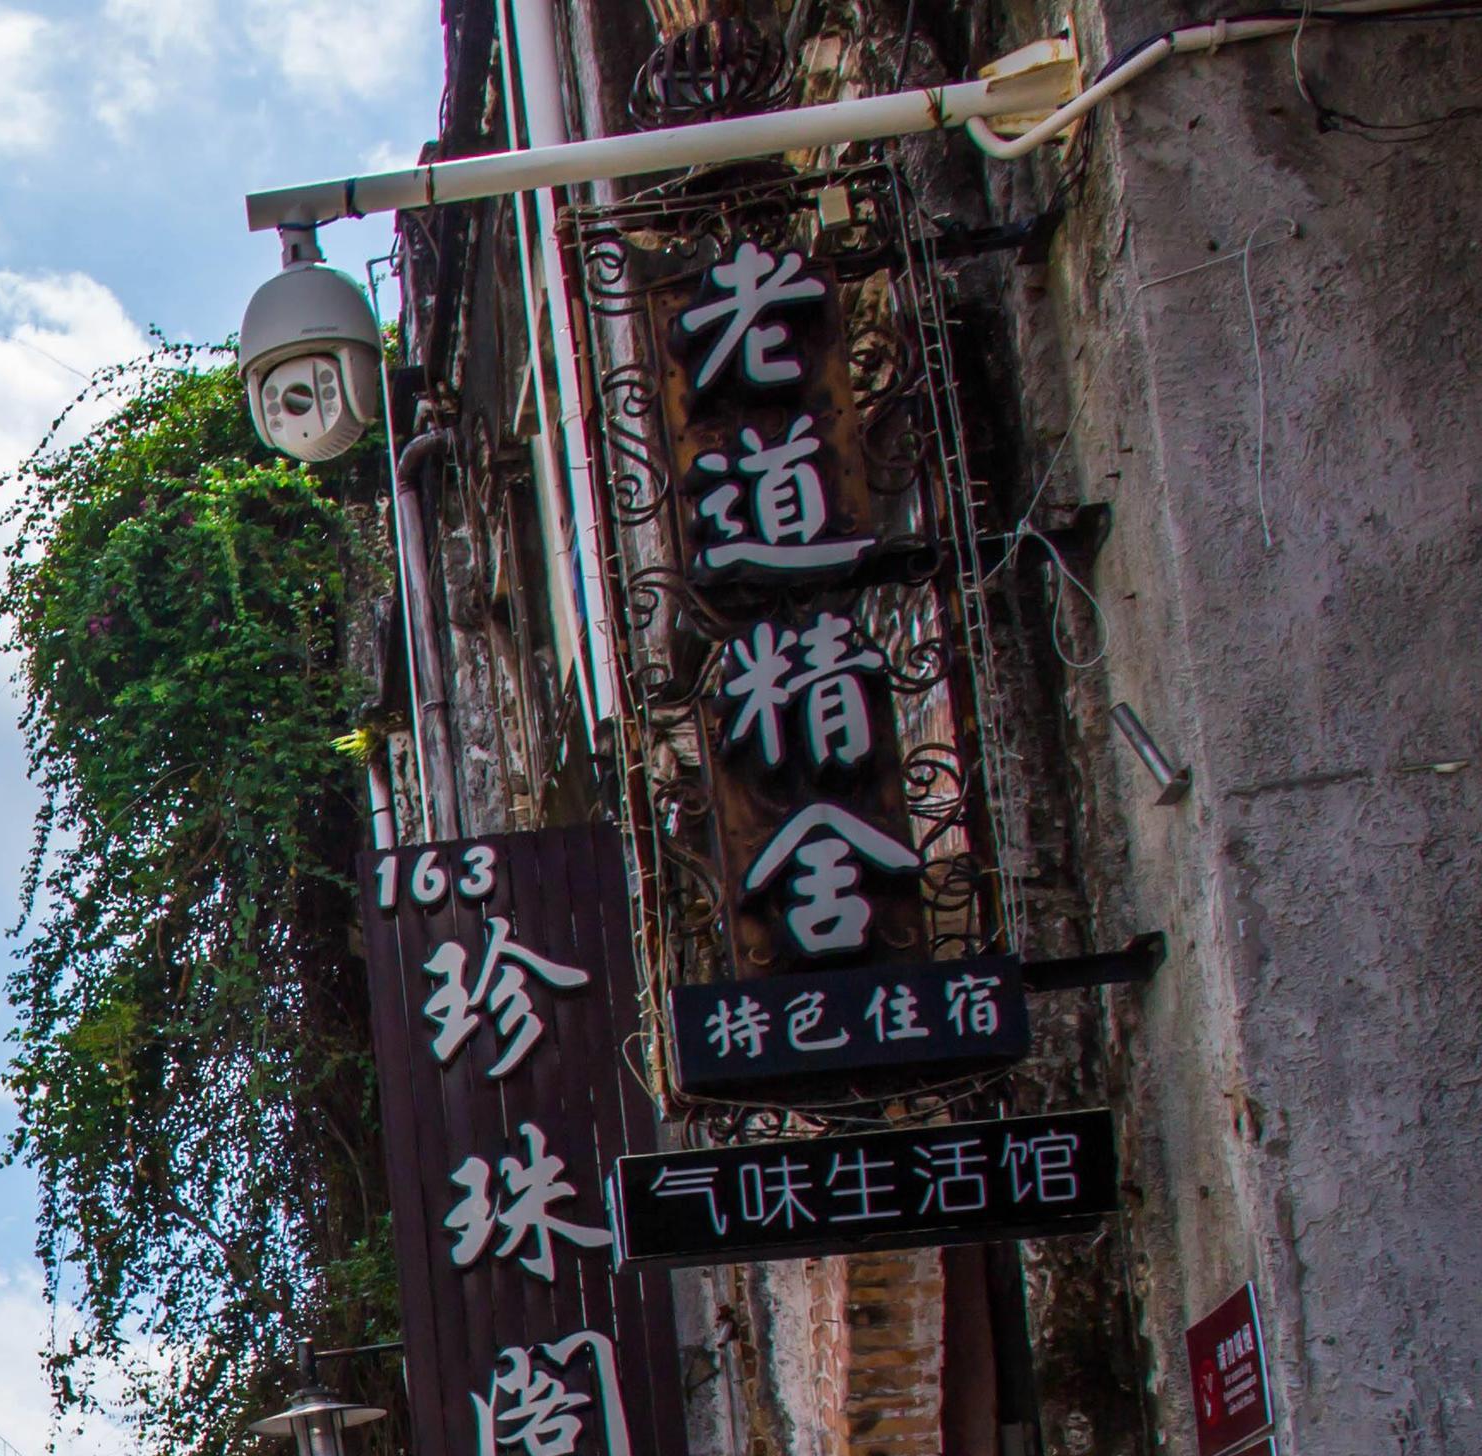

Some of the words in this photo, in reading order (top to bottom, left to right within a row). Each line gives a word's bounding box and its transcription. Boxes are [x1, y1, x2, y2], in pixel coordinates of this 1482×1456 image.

[682, 242, 922, 955] 老道精舍
[376, 846, 497, 909] 163
[706, 974, 1004, 1061] 特色住宿
[651, 1131, 1081, 1236] 气味生活馆
